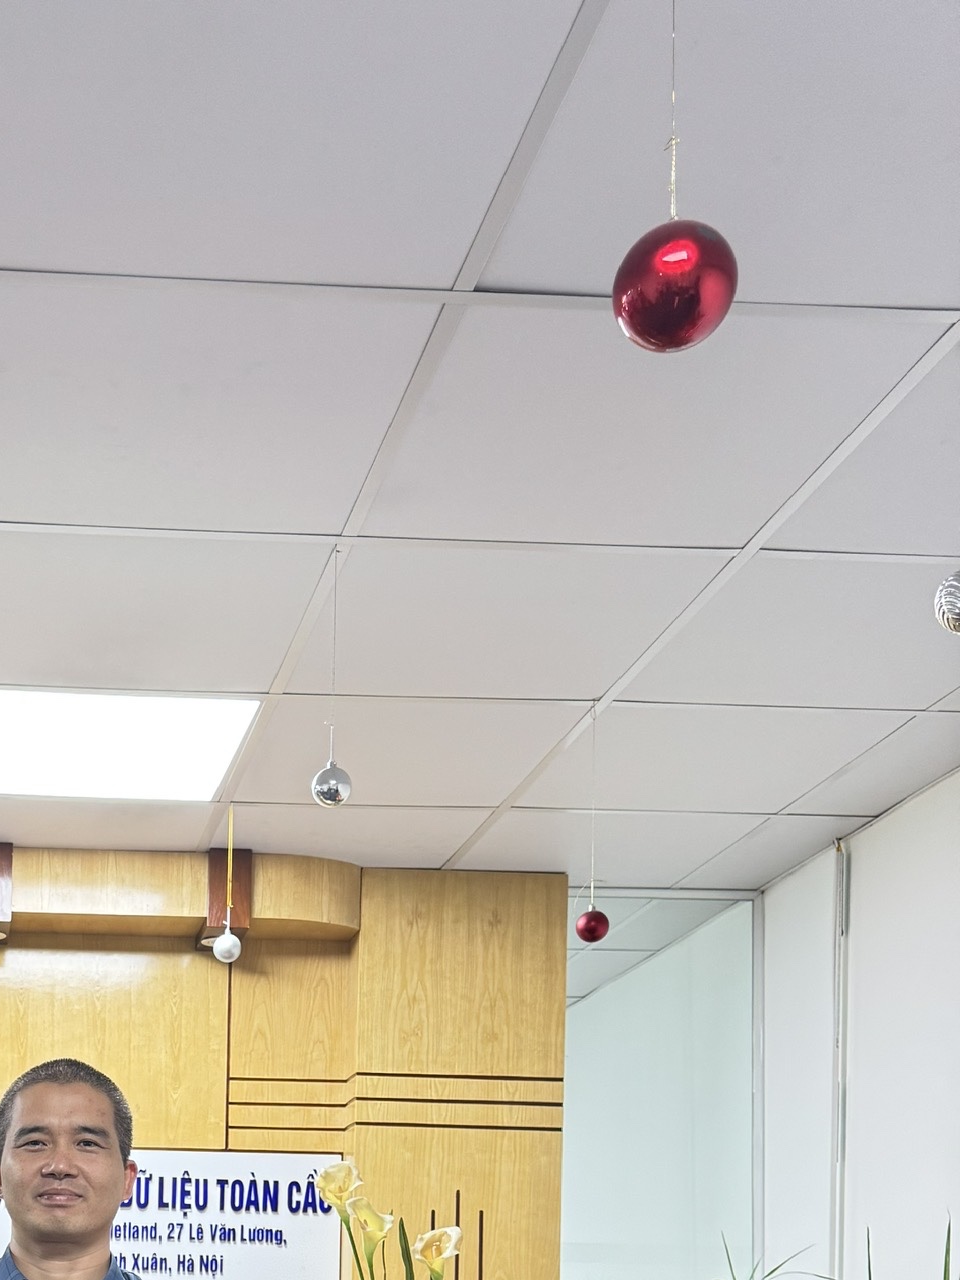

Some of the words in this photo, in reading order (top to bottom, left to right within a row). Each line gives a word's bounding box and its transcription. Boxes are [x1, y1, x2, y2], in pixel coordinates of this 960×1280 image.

[157, 1170, 209, 1218] LIỆU
[216, 1171, 280, 1214] TOÀN
[110, 1221, 163, 1244] etland,
[167, 1222, 184, 1241] 27
[189, 1223, 204, 1242] Lê
[210, 1223, 237, 1243] Văn
[240, 1224, 288, 1247] Lương,
[131, 1252, 172, 1276] Xuân,
[177, 1253, 195, 1274] Hà
[199, 1254, 224, 1279] Nội
